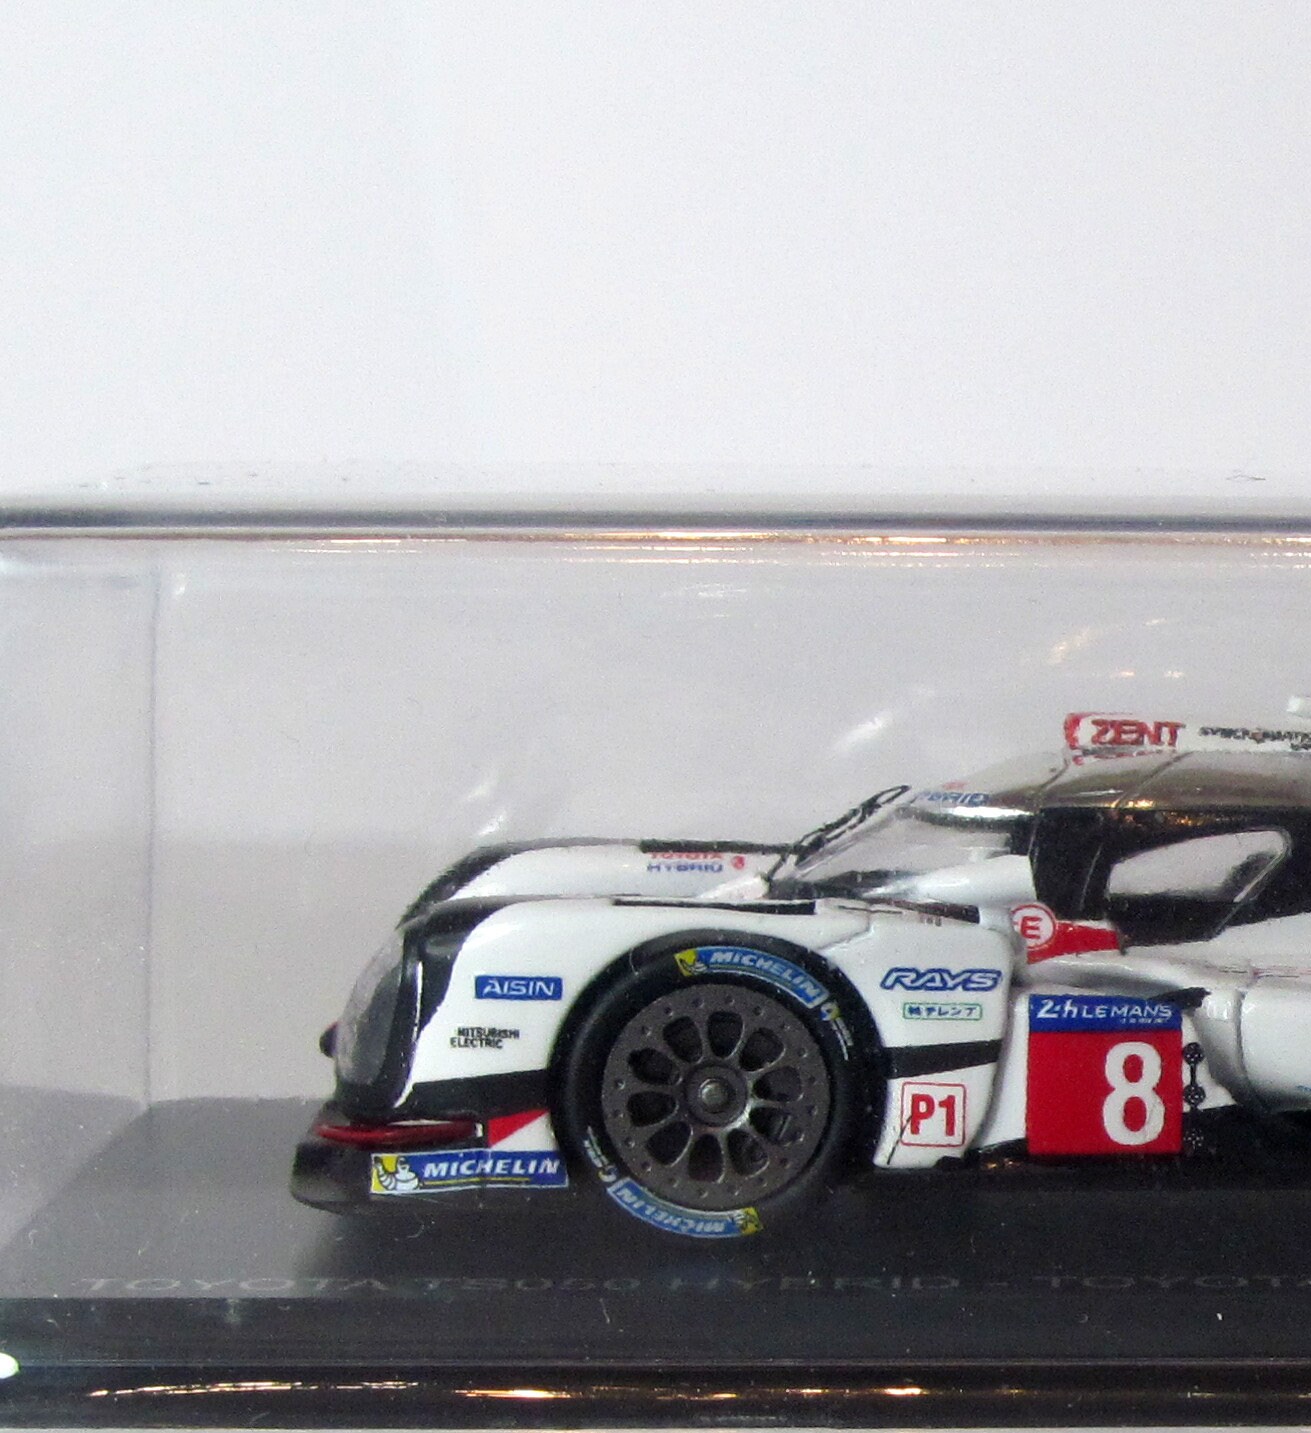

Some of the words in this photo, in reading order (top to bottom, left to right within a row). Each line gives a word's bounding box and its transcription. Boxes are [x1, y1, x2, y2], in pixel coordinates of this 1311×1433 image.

[1091, 719, 1186, 747] ZENT
[1020, 915, 1043, 940] E
[709, 950, 823, 1000] MICHELIN
[880, 967, 1002, 991] RAYS
[482, 979, 555, 997] AISIN
[450, 1037, 503, 1049] ELECTRIC
[1103, 1042, 1165, 1146] 8
[910, 1093, 956, 1137] P1
[423, 1158, 561, 1179] MICHELIN
[80, 1277, 390, 1291] TOYOTA
